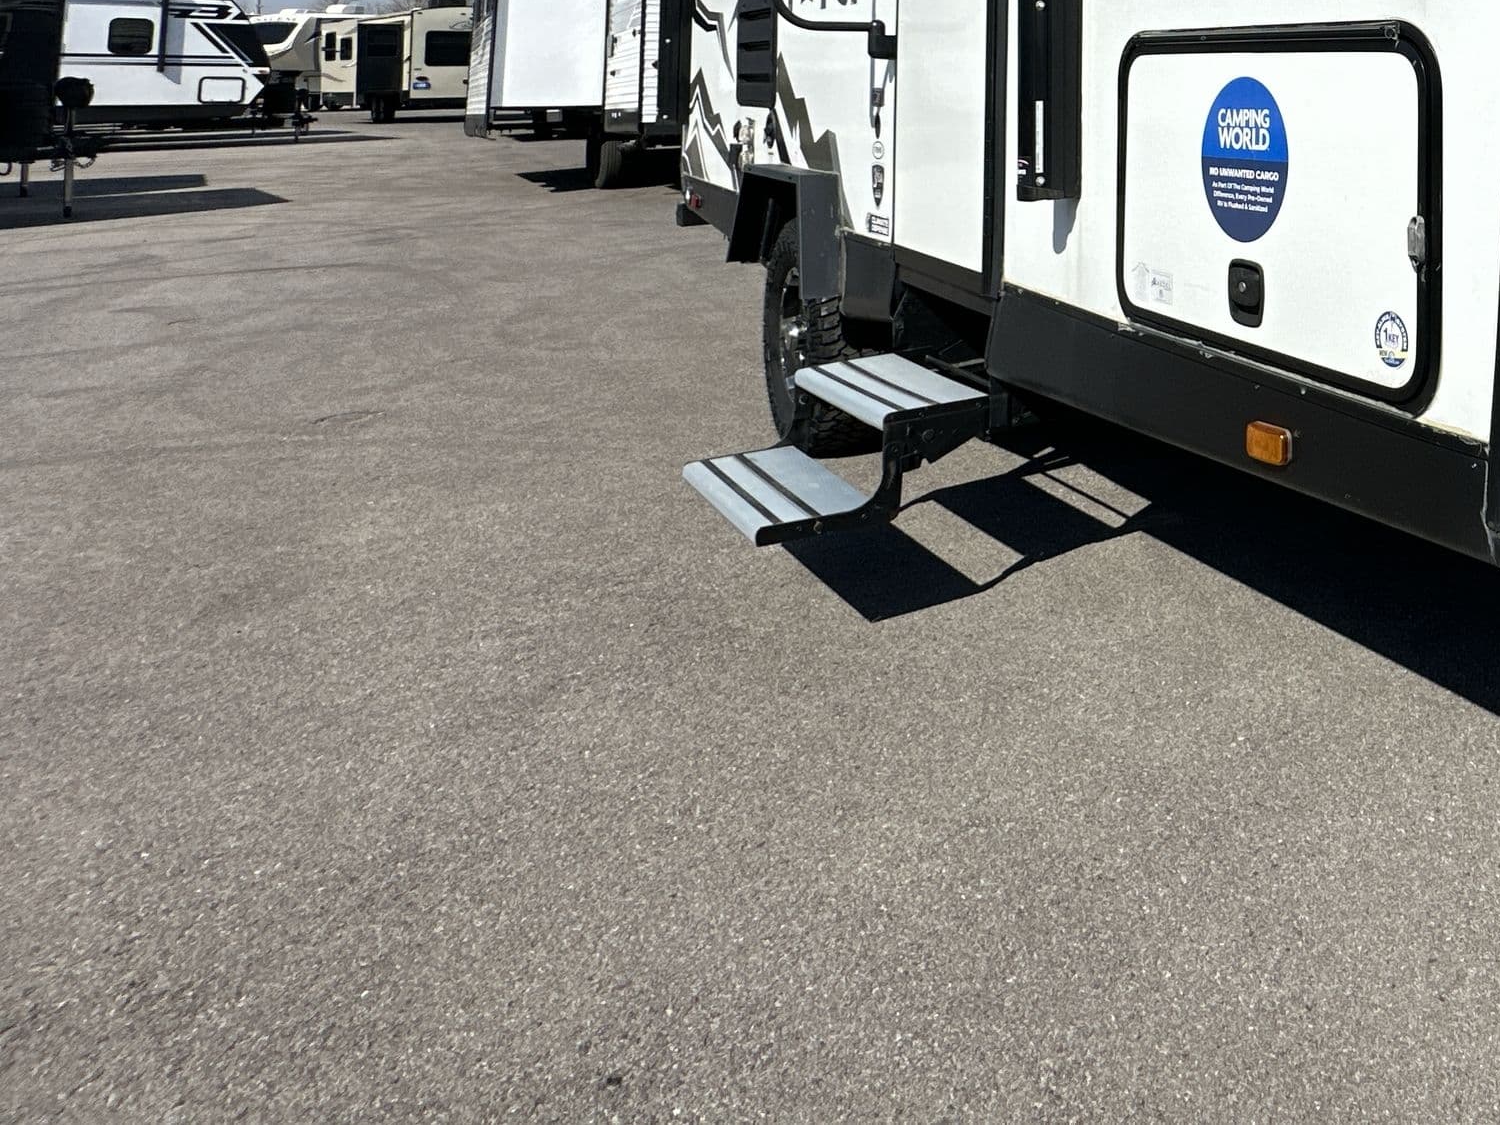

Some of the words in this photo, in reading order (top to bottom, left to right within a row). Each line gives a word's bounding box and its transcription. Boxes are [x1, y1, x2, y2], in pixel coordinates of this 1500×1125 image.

[1217, 108, 1271, 128] CAMPING
[1217, 126, 1271, 151] WORLD
[1209, 166, 1219, 176] NO
[1219, 167, 1255, 179] UNWANTED
[1255, 170, 1279, 181] CARGO
[1241, 184, 1260, 194] Camping
[1260, 186, 1275, 194] World
